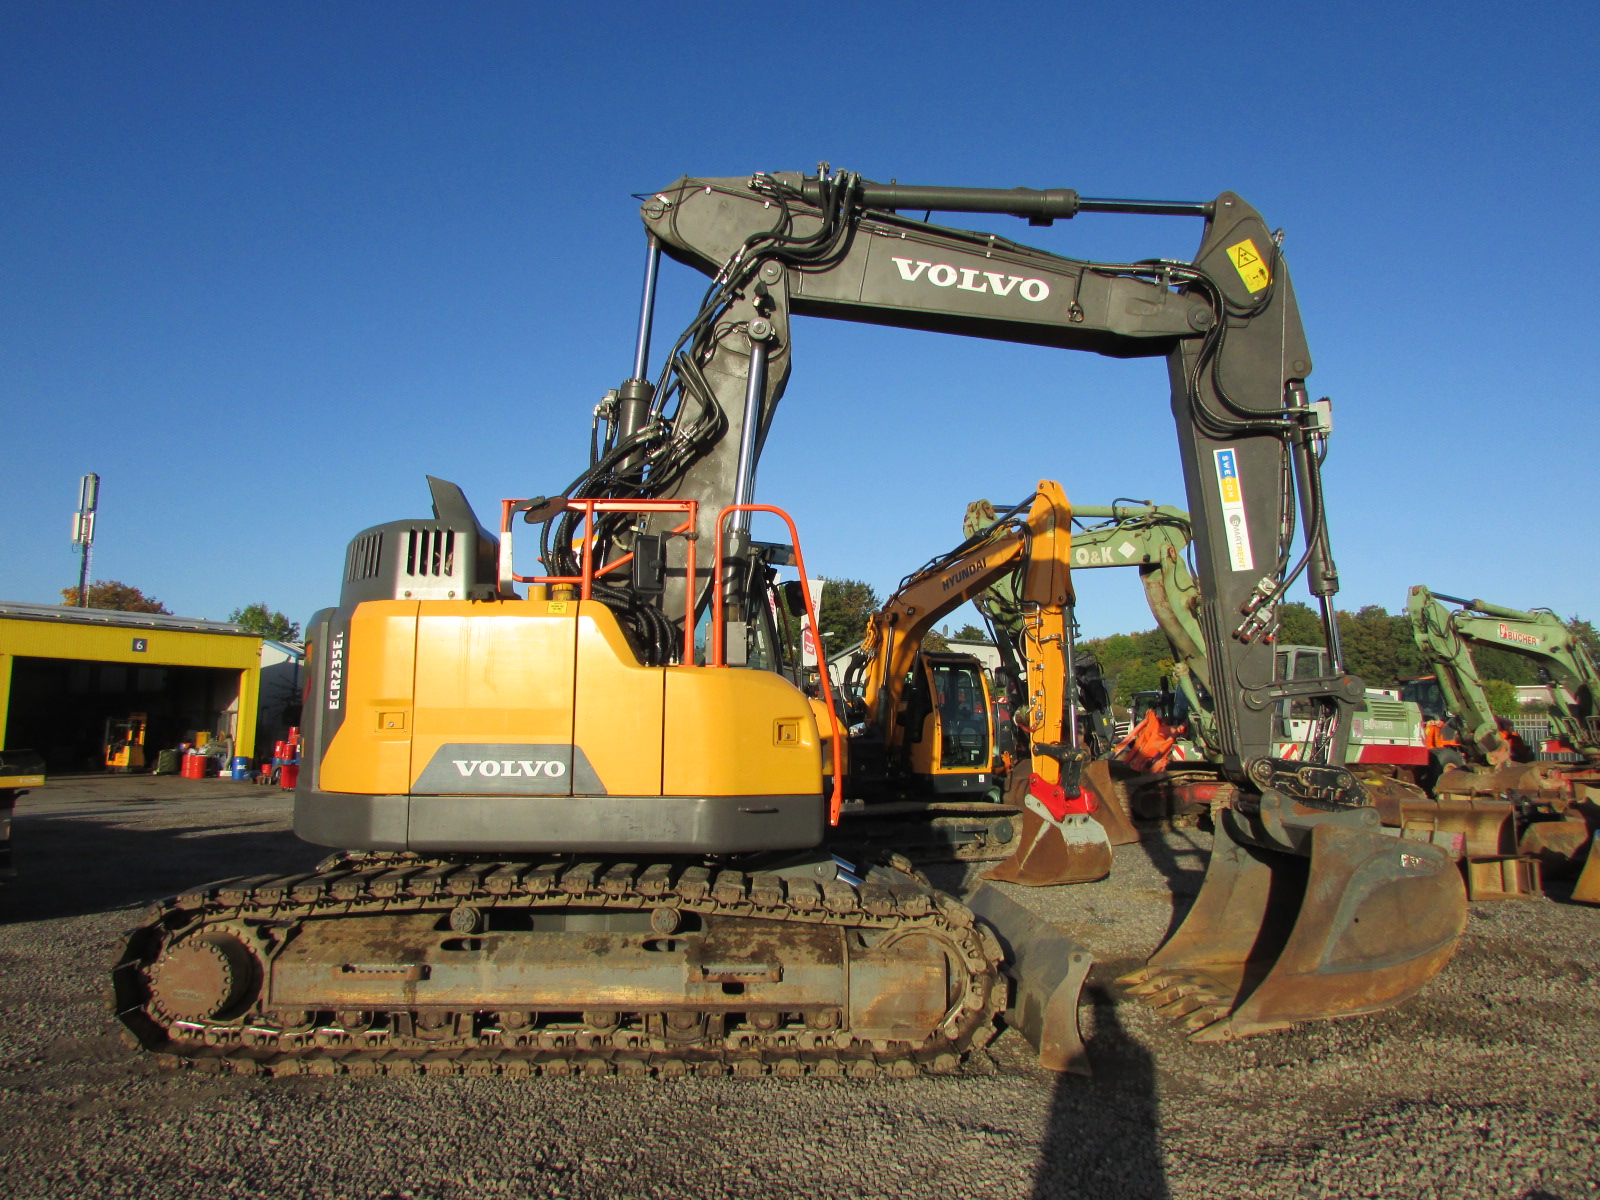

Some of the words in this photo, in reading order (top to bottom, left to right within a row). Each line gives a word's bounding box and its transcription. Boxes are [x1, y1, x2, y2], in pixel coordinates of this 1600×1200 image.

[891, 256, 1050, 302] VOLVO
[1221, 455, 1235, 498] SWECON
[1075, 546, 1114, 565] O&K
[942, 557, 987, 591] HYUNDAI
[136, 640, 144, 650] 6
[328, 631, 344, 710] ECR235EL
[452, 760, 566, 778] VOLVO
